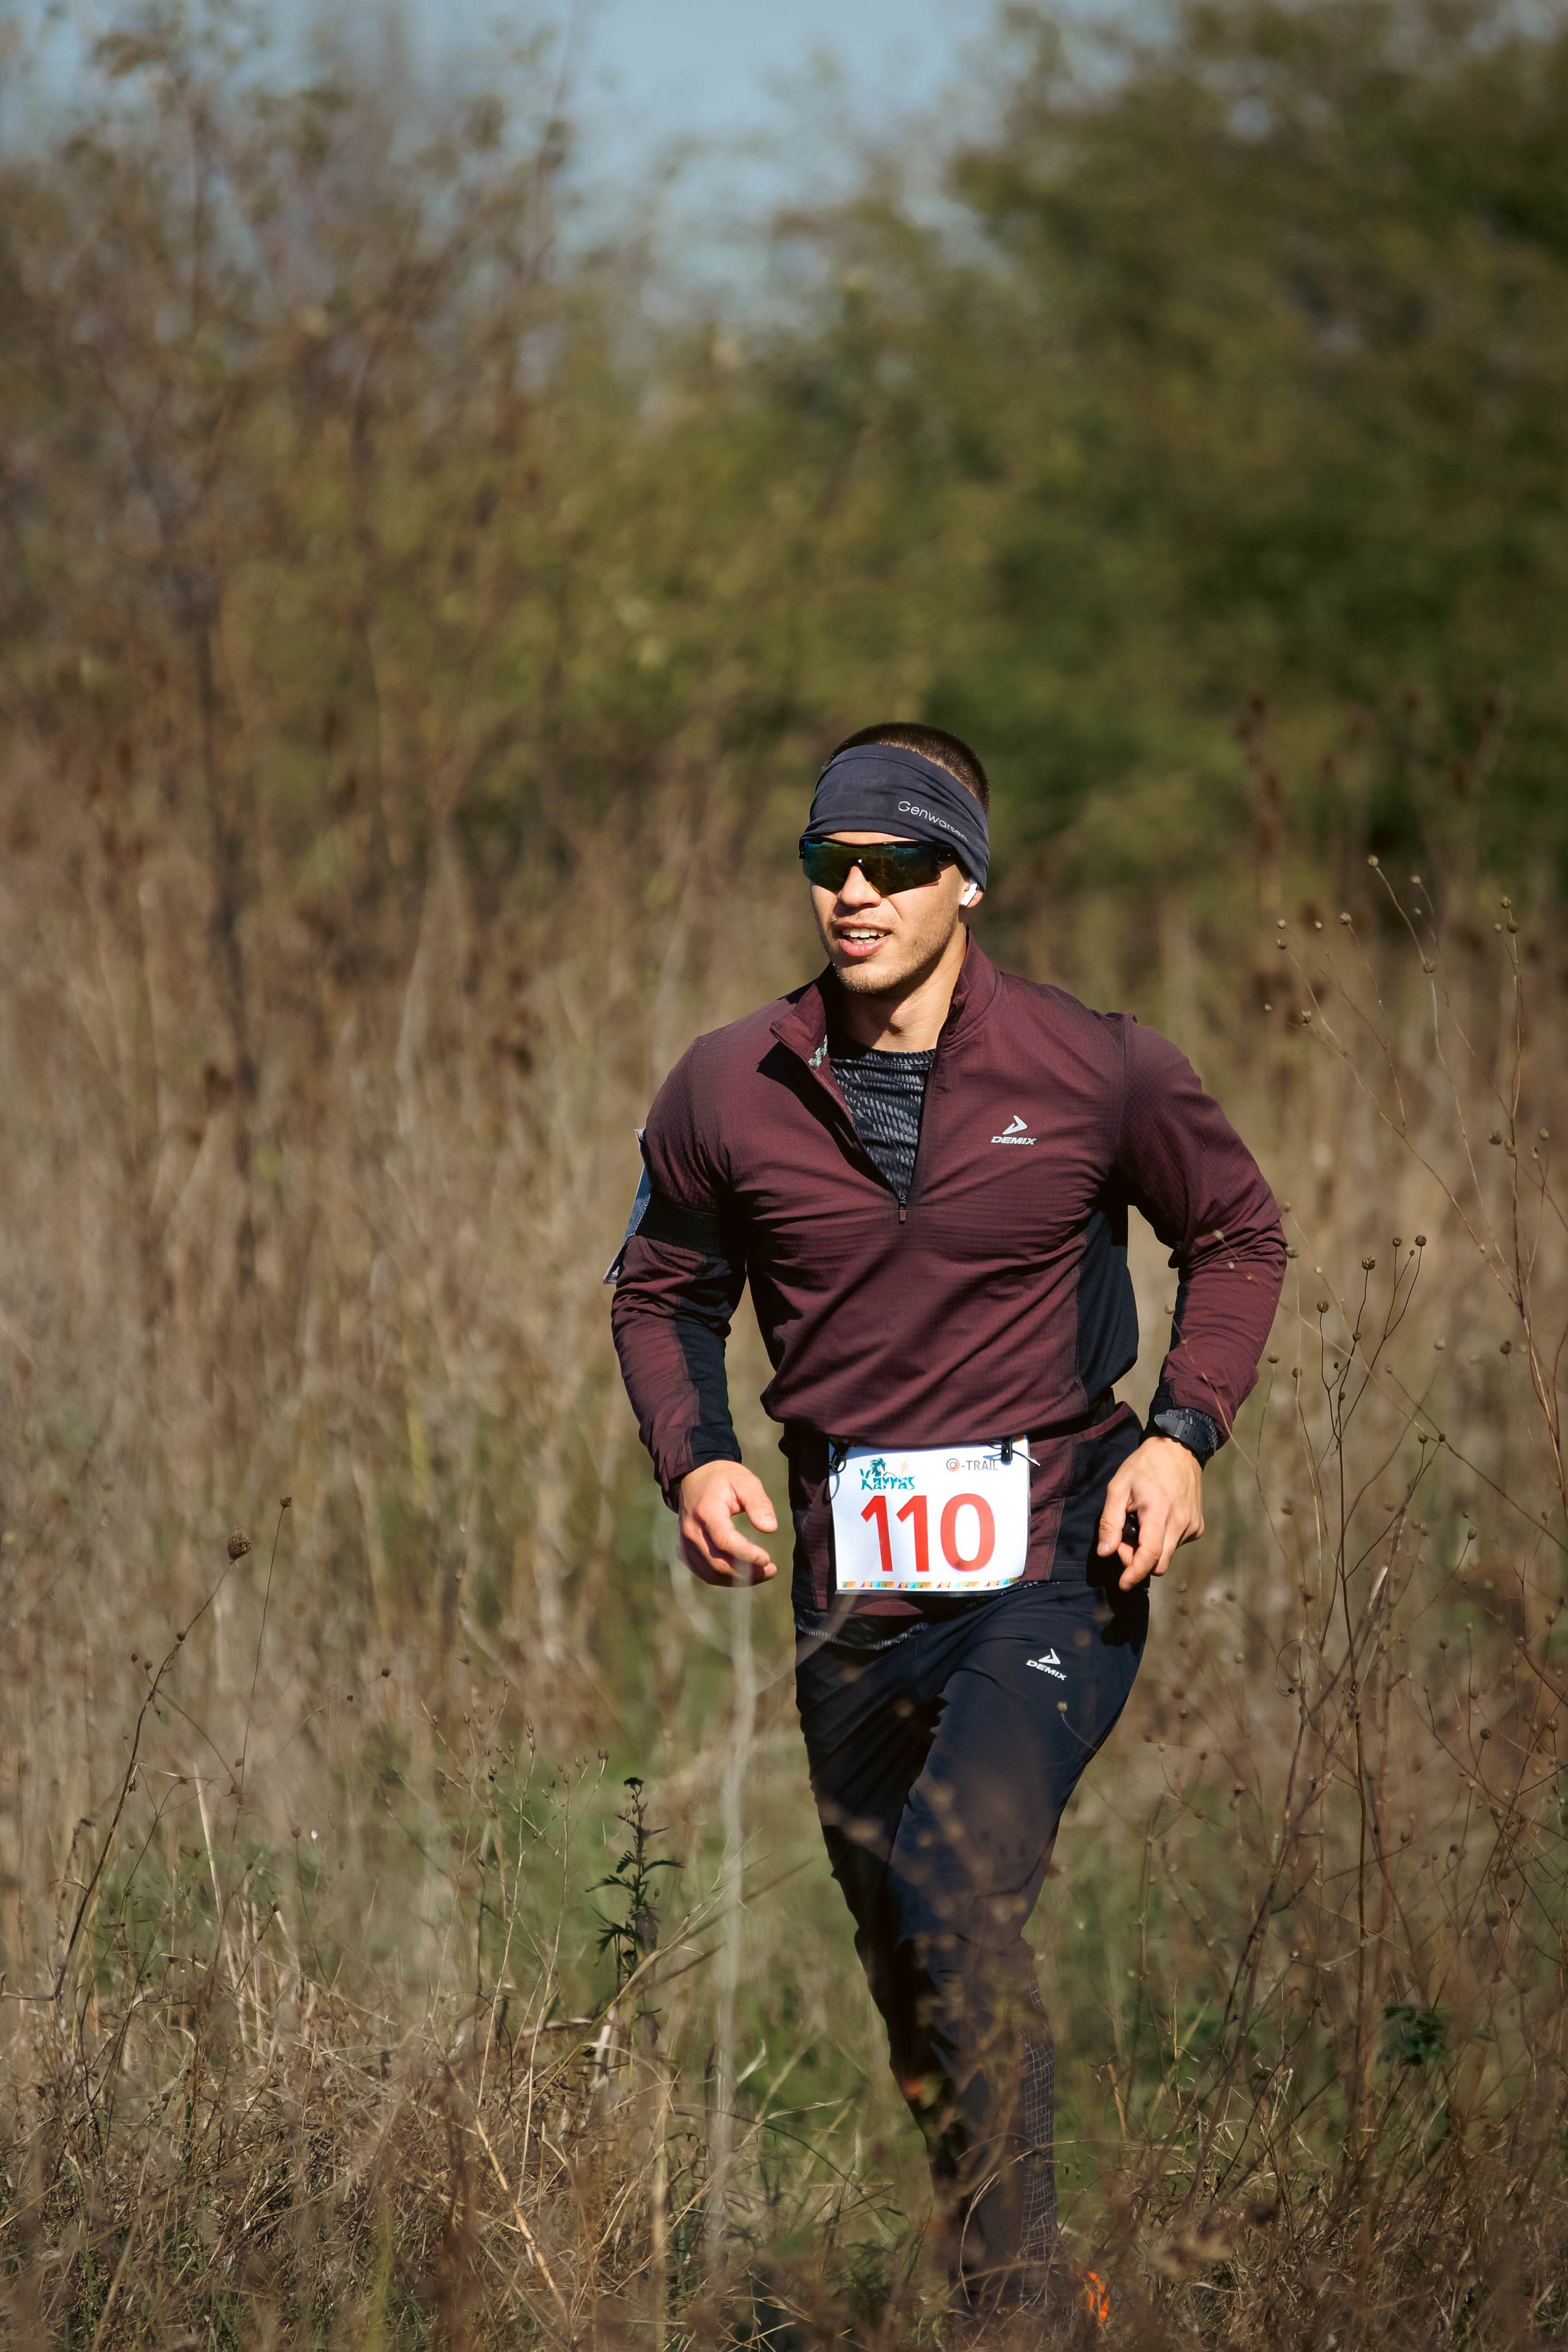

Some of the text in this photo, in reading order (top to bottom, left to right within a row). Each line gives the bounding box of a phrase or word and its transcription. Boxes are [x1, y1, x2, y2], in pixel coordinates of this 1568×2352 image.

[898, 801, 968, 842] Genwarsen
[990, 1136, 1037, 1145] DEMIX
[860, 1468, 915, 1491] Karras
[861, 1493, 995, 1572] 110
[1026, 1660, 1066, 1681] DEMIX
